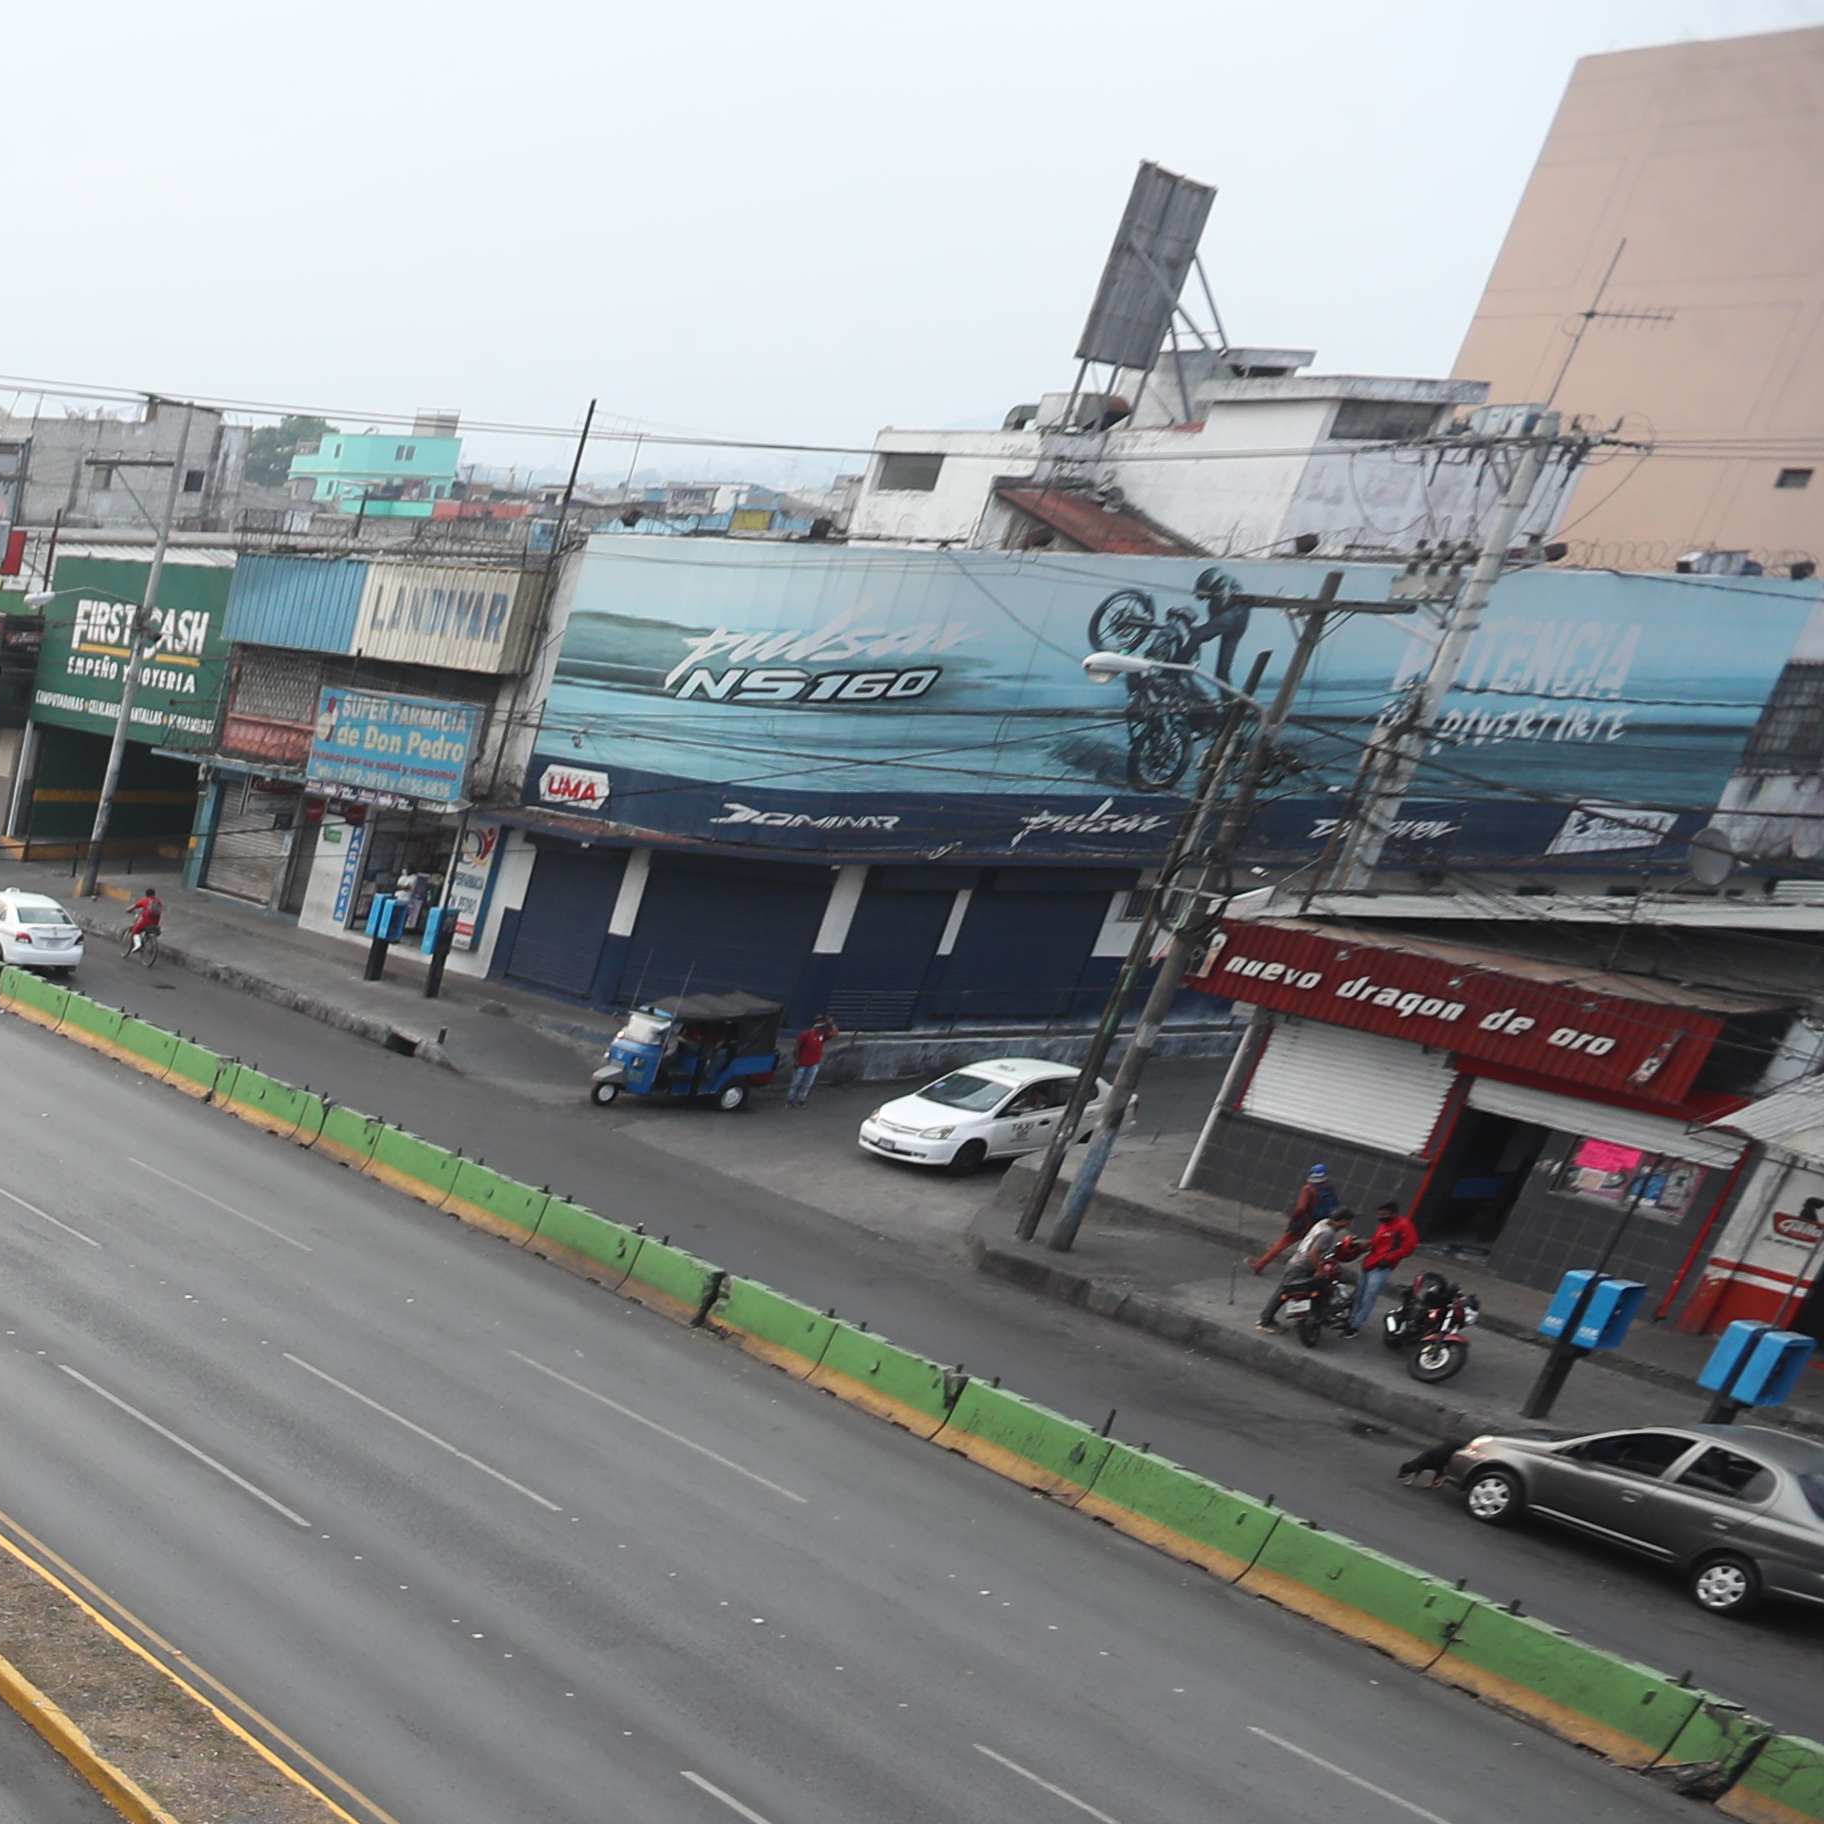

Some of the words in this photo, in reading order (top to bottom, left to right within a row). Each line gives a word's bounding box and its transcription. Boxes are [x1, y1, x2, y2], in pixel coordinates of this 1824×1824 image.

[71, 599, 138, 650] FIRST
[142, 606, 210, 660] CASH
[663, 590, 988, 690] pulsar
[67, 655, 118, 680] EMPEÑO
[675, 666, 943, 700] NS160
[130, 707, 163, 726] ANTALLAS
[341, 695, 390, 721] SUPER
[392, 700, 468, 733] FARMACIA
[337, 722, 360, 747] de
[364, 725, 401, 754] Don
[406, 731, 466, 762] Pedro
[547, 774, 599, 801] UMA
[1224, 954, 1323, 990] nuevo
[1335, 976, 1466, 1022] dragon
[1478, 1007, 1536, 1036] de
[1546, 1026, 1617, 1056] oro
[1012, 1122, 1035, 1133] TAXI
